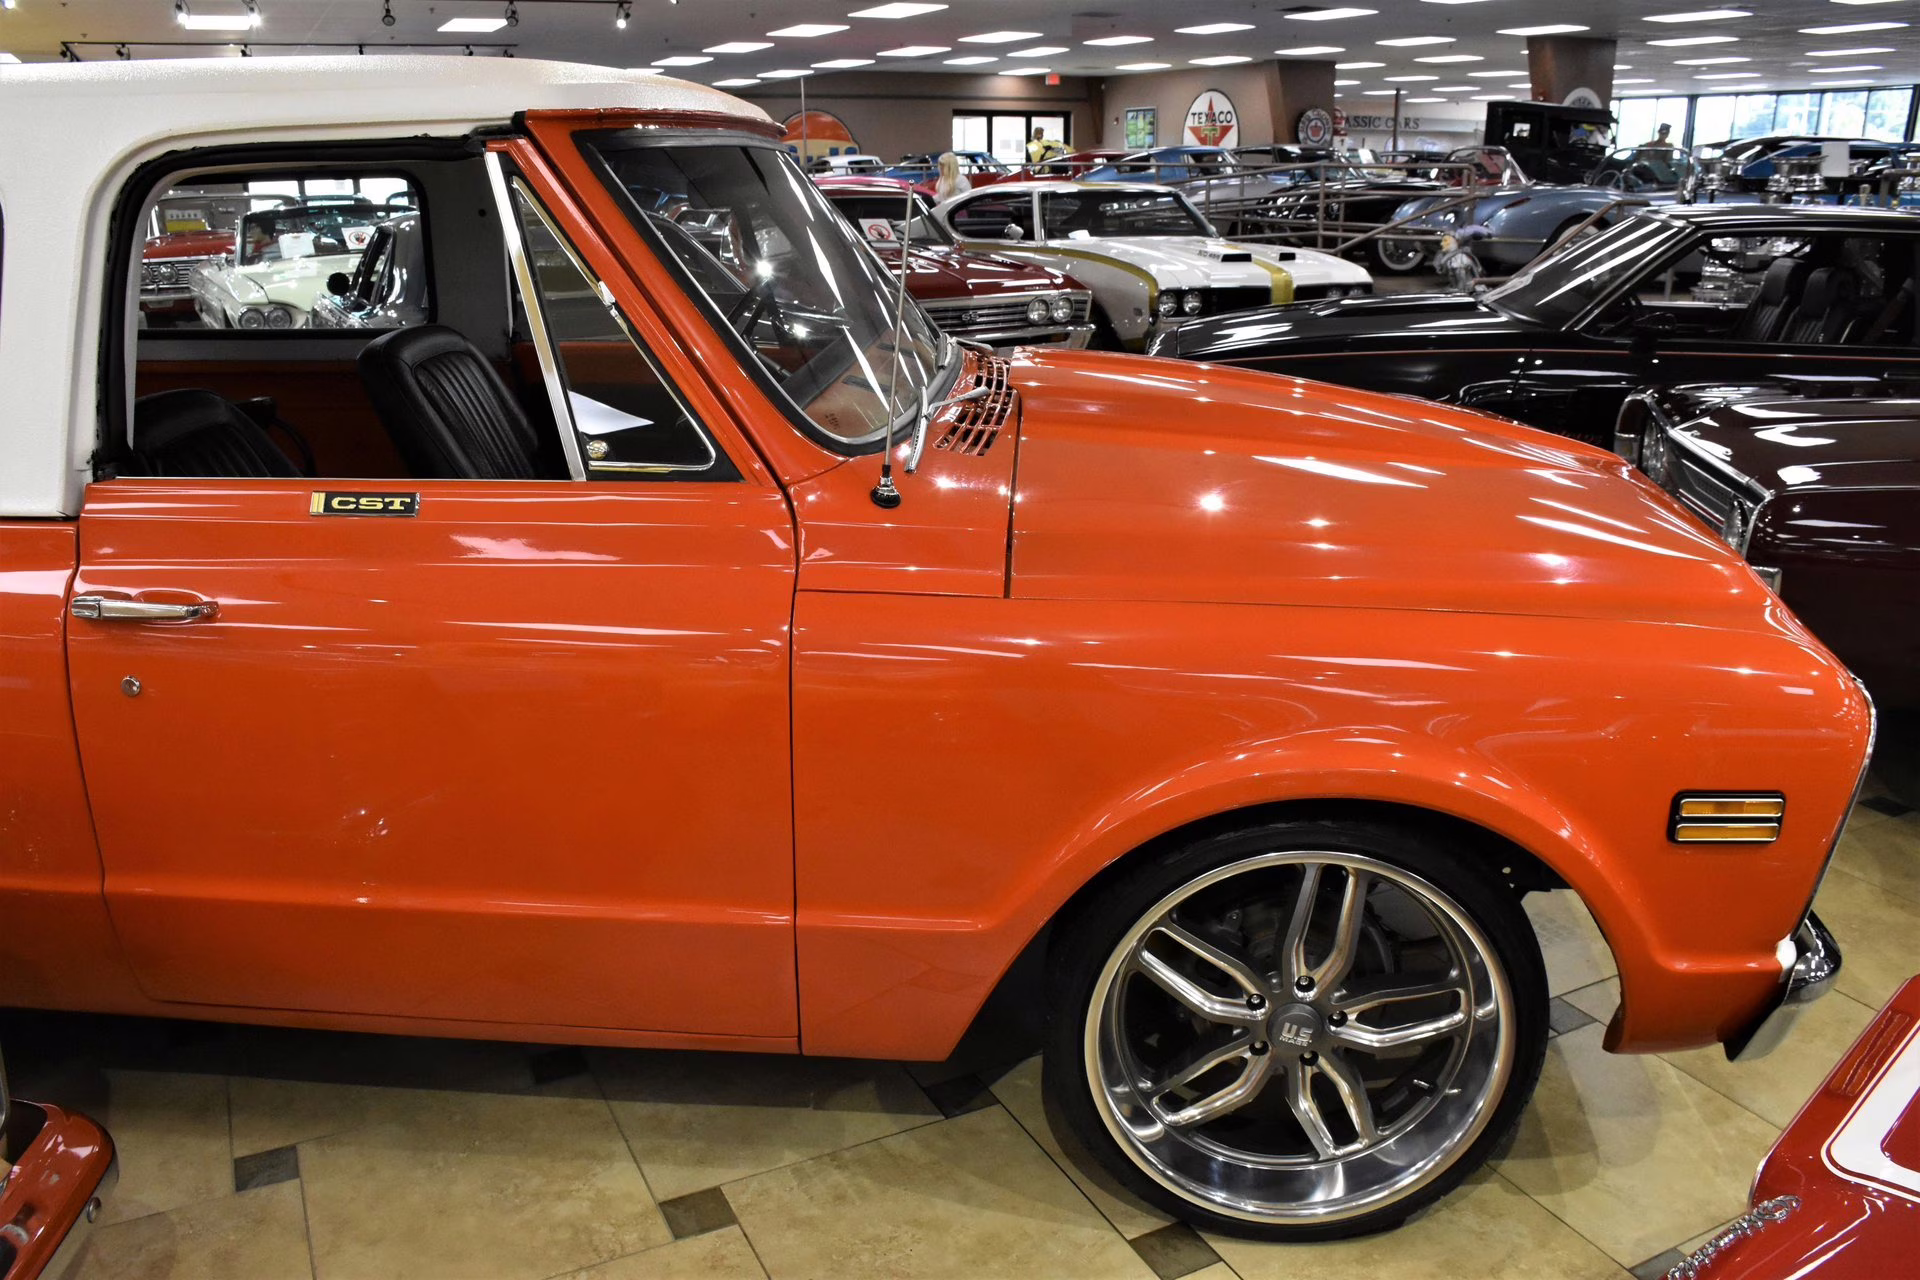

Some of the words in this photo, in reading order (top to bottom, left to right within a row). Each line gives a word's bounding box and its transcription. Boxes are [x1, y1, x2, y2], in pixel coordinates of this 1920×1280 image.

[1191, 110, 1233, 125] TEXACO
[1344, 115, 1380, 129] ASSIC
[1385, 116, 1420, 130] CRS
[962, 310, 979, 321] SS
[331, 497, 411, 510] CST
